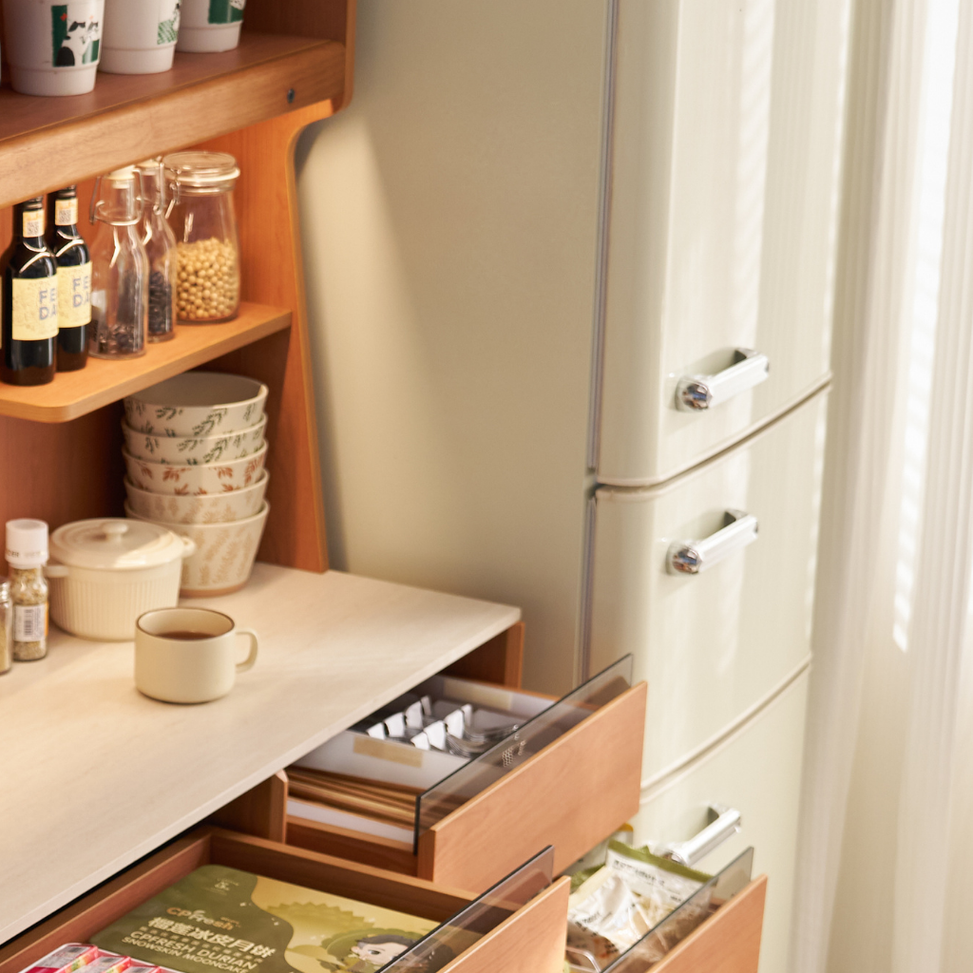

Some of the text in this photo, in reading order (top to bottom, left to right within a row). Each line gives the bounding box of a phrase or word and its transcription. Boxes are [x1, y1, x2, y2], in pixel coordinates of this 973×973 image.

[122, 936, 183, 957] SNOWSKIN
[130, 931, 196, 953] CPFRESH
[197, 949, 258, 970] DURIAN
